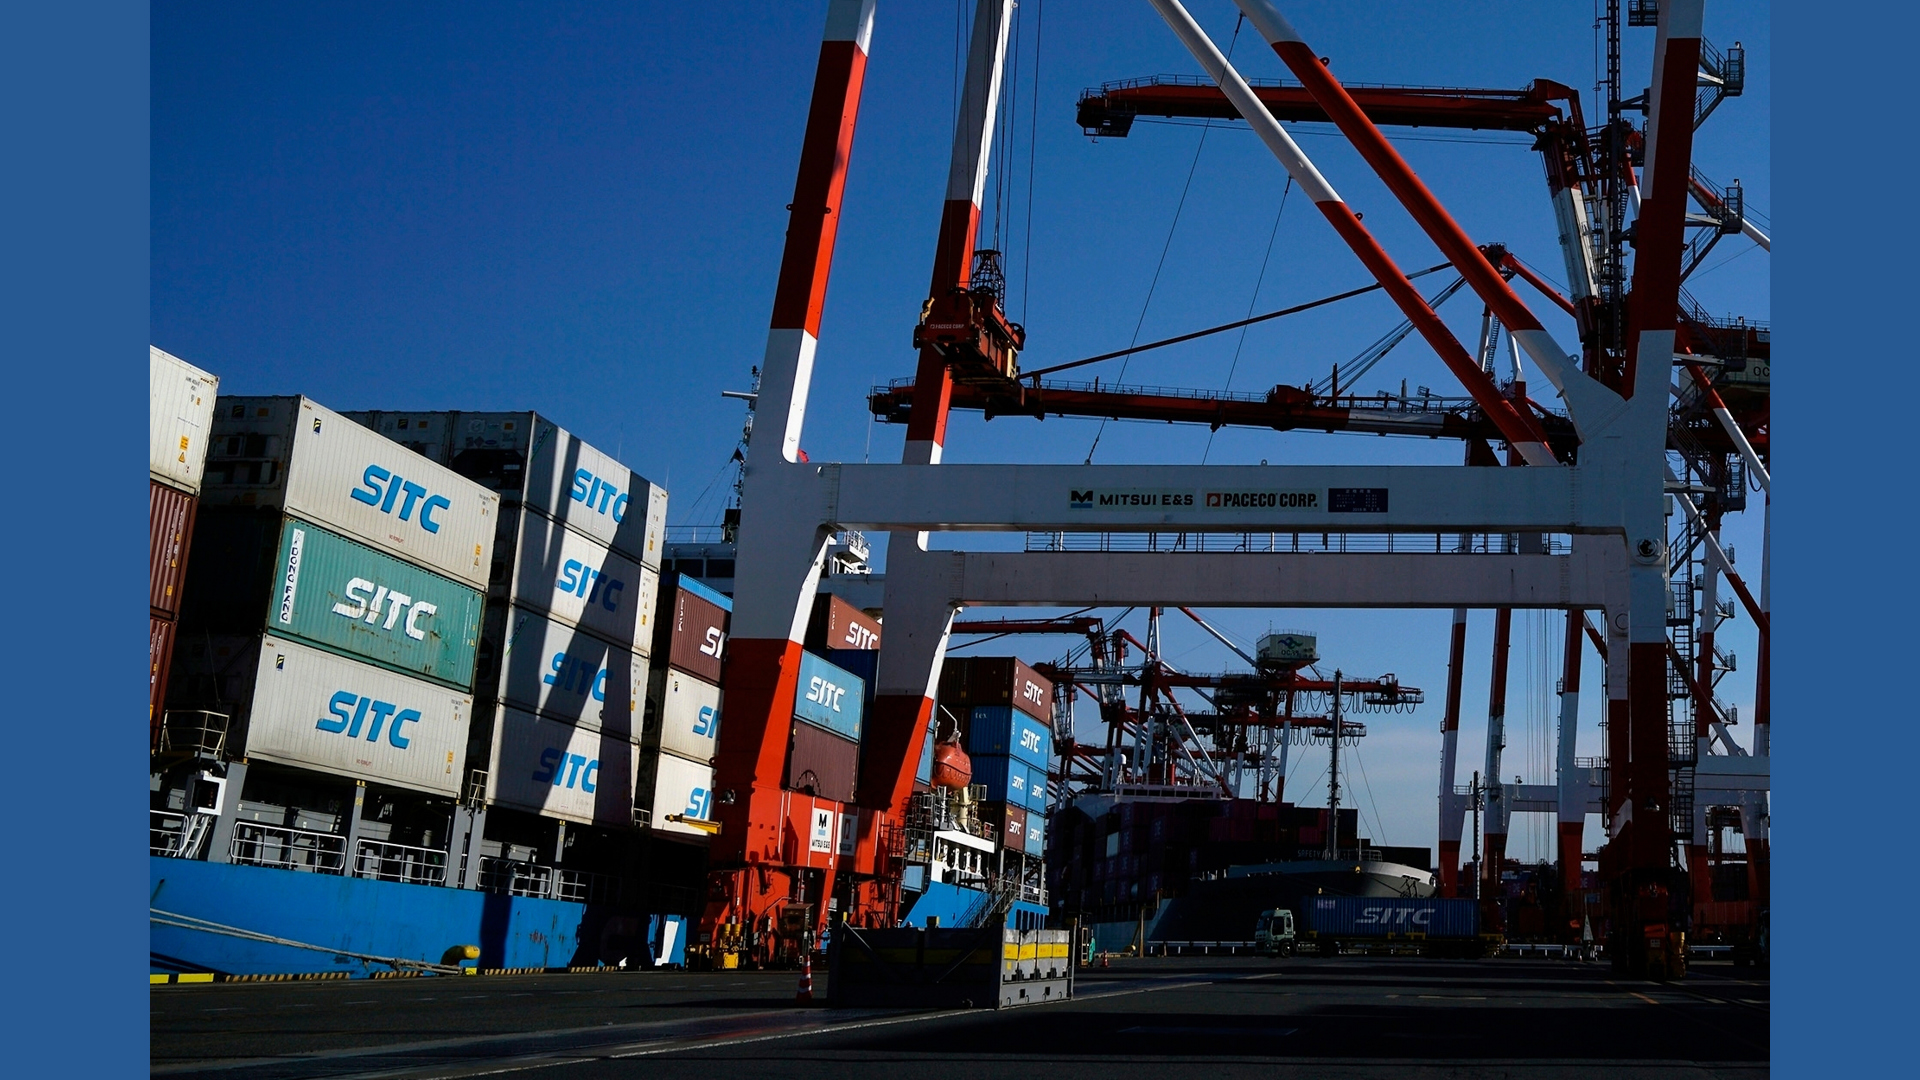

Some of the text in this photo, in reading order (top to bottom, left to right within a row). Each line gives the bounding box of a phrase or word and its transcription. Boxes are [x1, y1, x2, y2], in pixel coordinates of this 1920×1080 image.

[350, 464, 451, 534] SITC
[567, 467, 634, 526] SITC
[1099, 494, 1194, 506] MITSUI E&S
[1223, 493, 1318, 508] PACECO CORP.
[555, 558, 625, 612] SITC
[332, 576, 438, 641] SITC
[700, 625, 727, 660] SI
[845, 620, 879, 650] SITC
[543, 651, 614, 703] SITC
[805, 674, 846, 713] SITC
[1023, 679, 1044, 707] SITC
[315, 690, 422, 749] SITC
[692, 705, 722, 739] SI
[1020, 727, 1041, 754] SITC
[531, 747, 604, 794] SITC
[1011, 775, 1024, 791] SITC
[684, 787, 715, 820] SI
[1031, 784, 1044, 799] SITC
[1008, 820, 1022, 835] SITC
[1029, 827, 1041, 842] SITC
[1355, 906, 1437, 925] SITC
